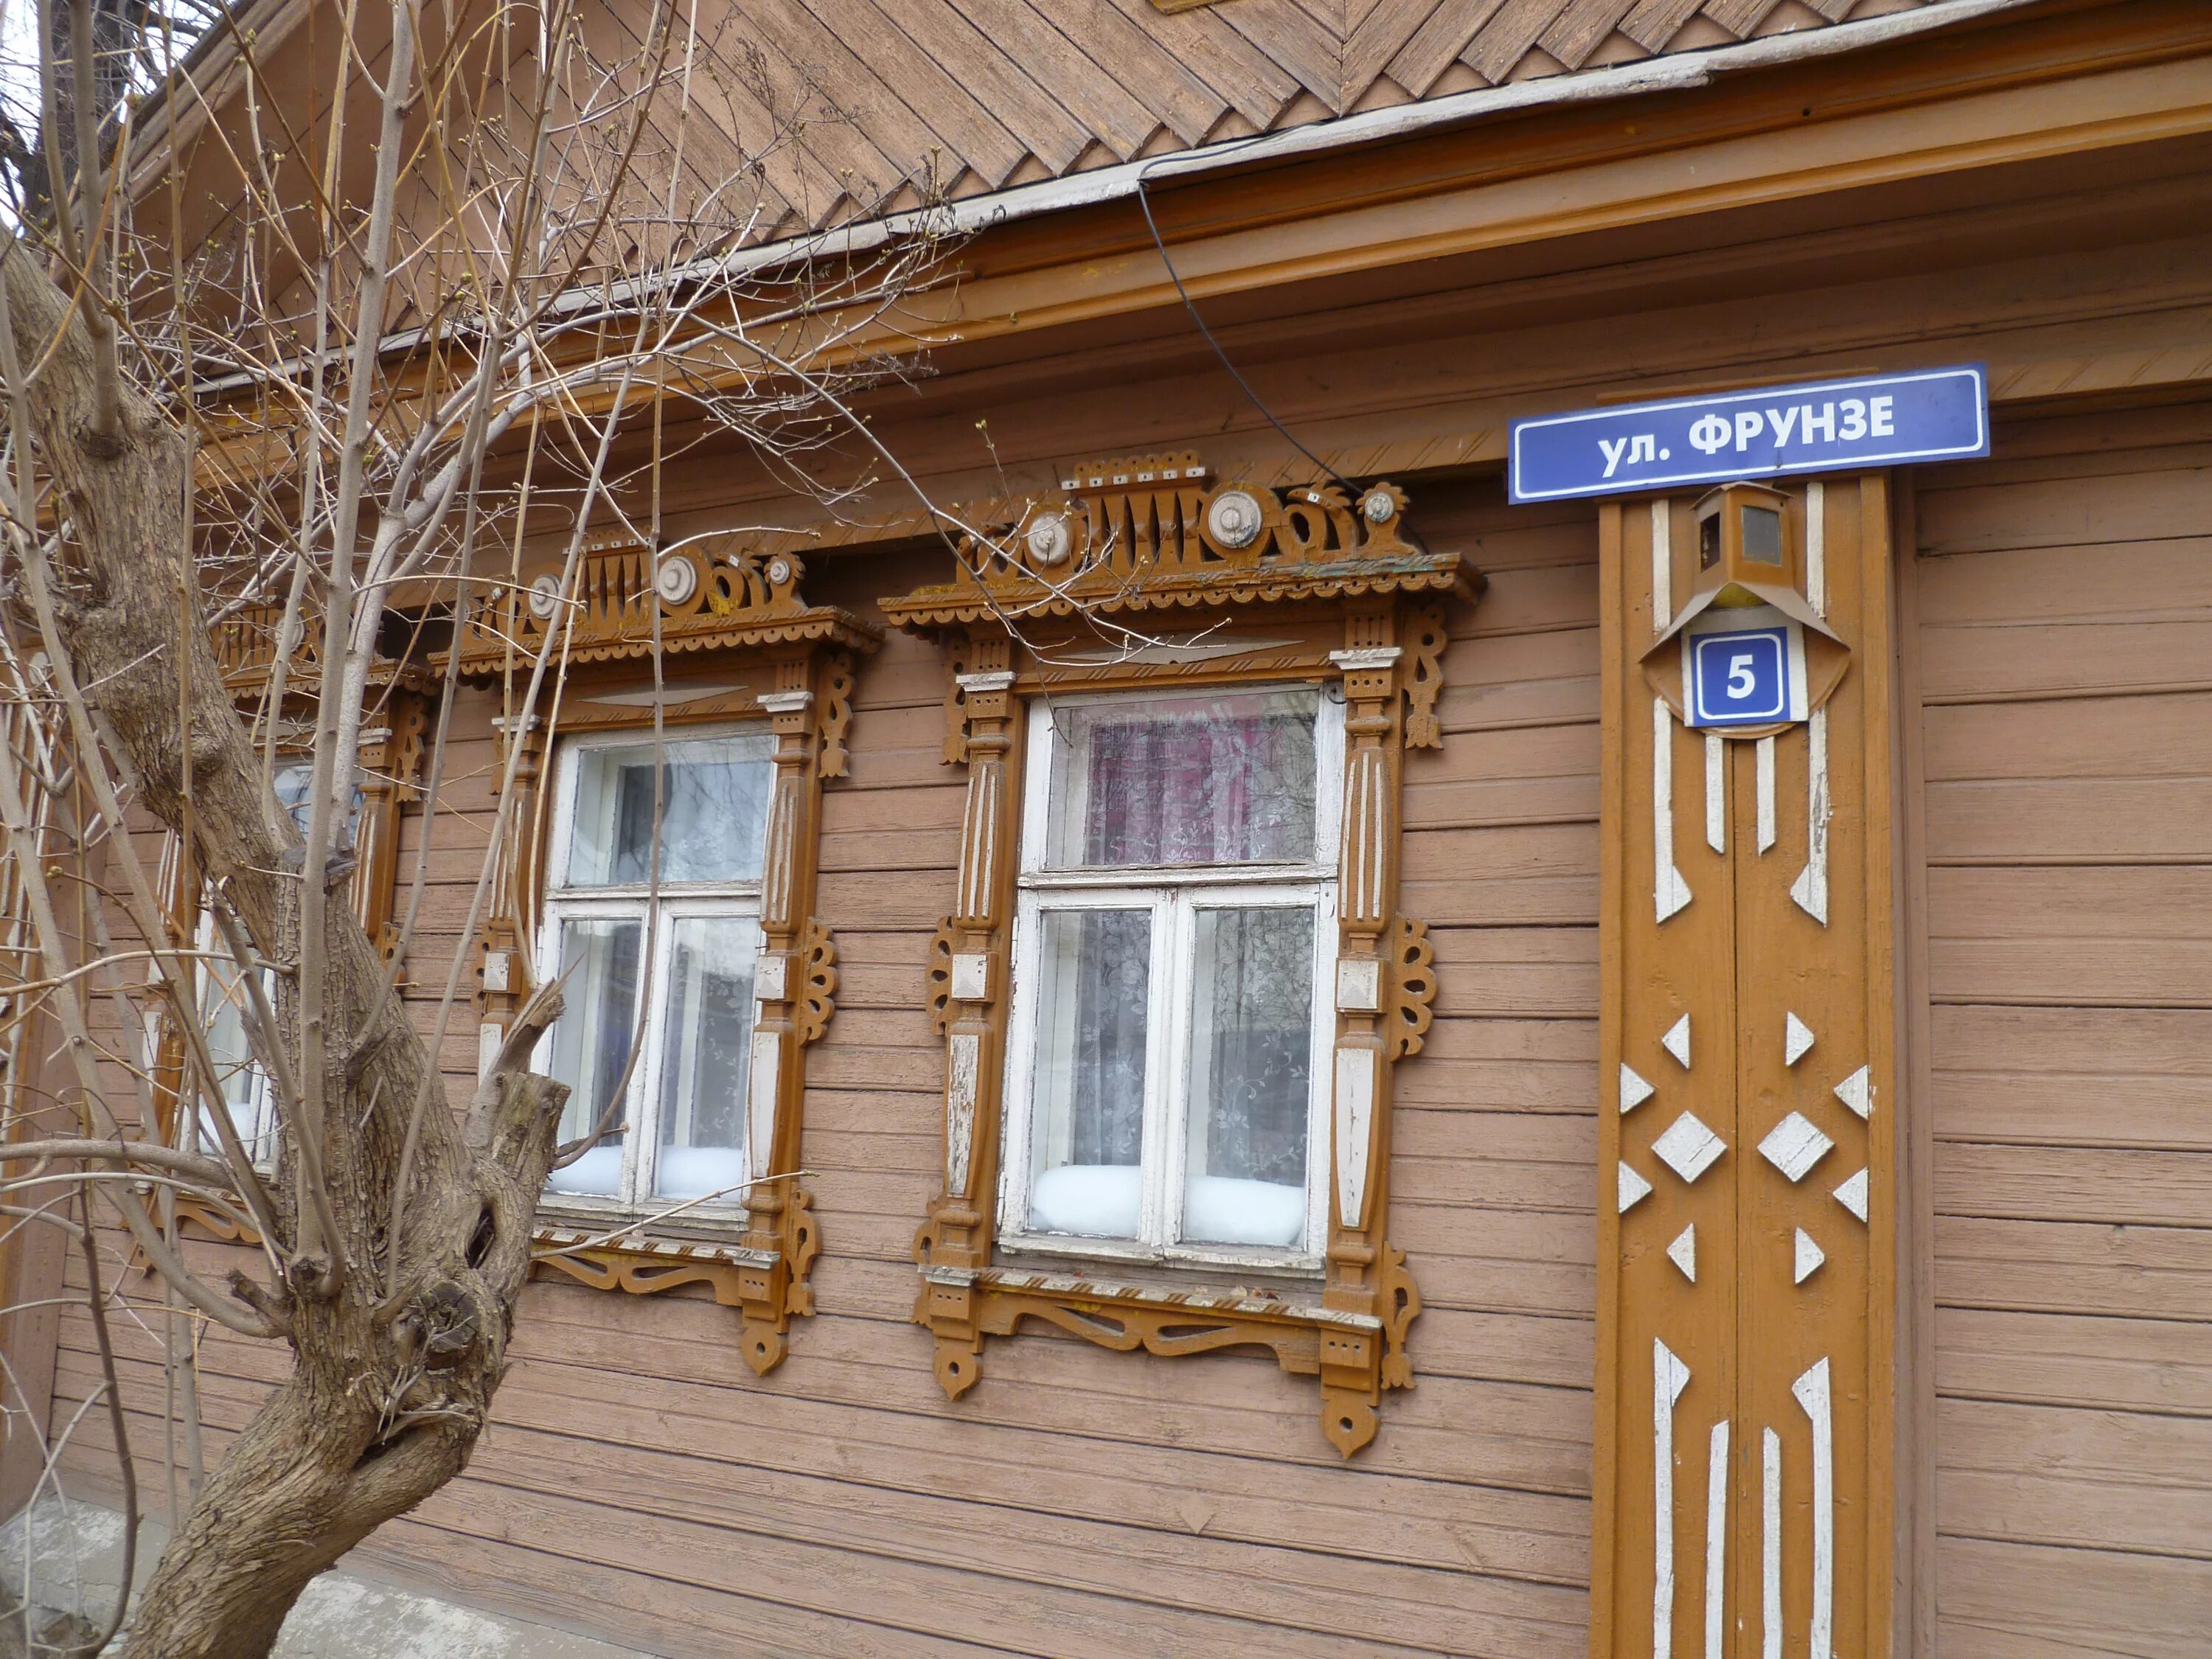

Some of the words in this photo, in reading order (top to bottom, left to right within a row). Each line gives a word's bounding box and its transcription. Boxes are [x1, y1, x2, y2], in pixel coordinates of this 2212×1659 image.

[1598, 434, 1671, 479] ул.
[1688, 395, 1895, 455] ФРУНЗЕ
[1727, 654, 1756, 699] 5
